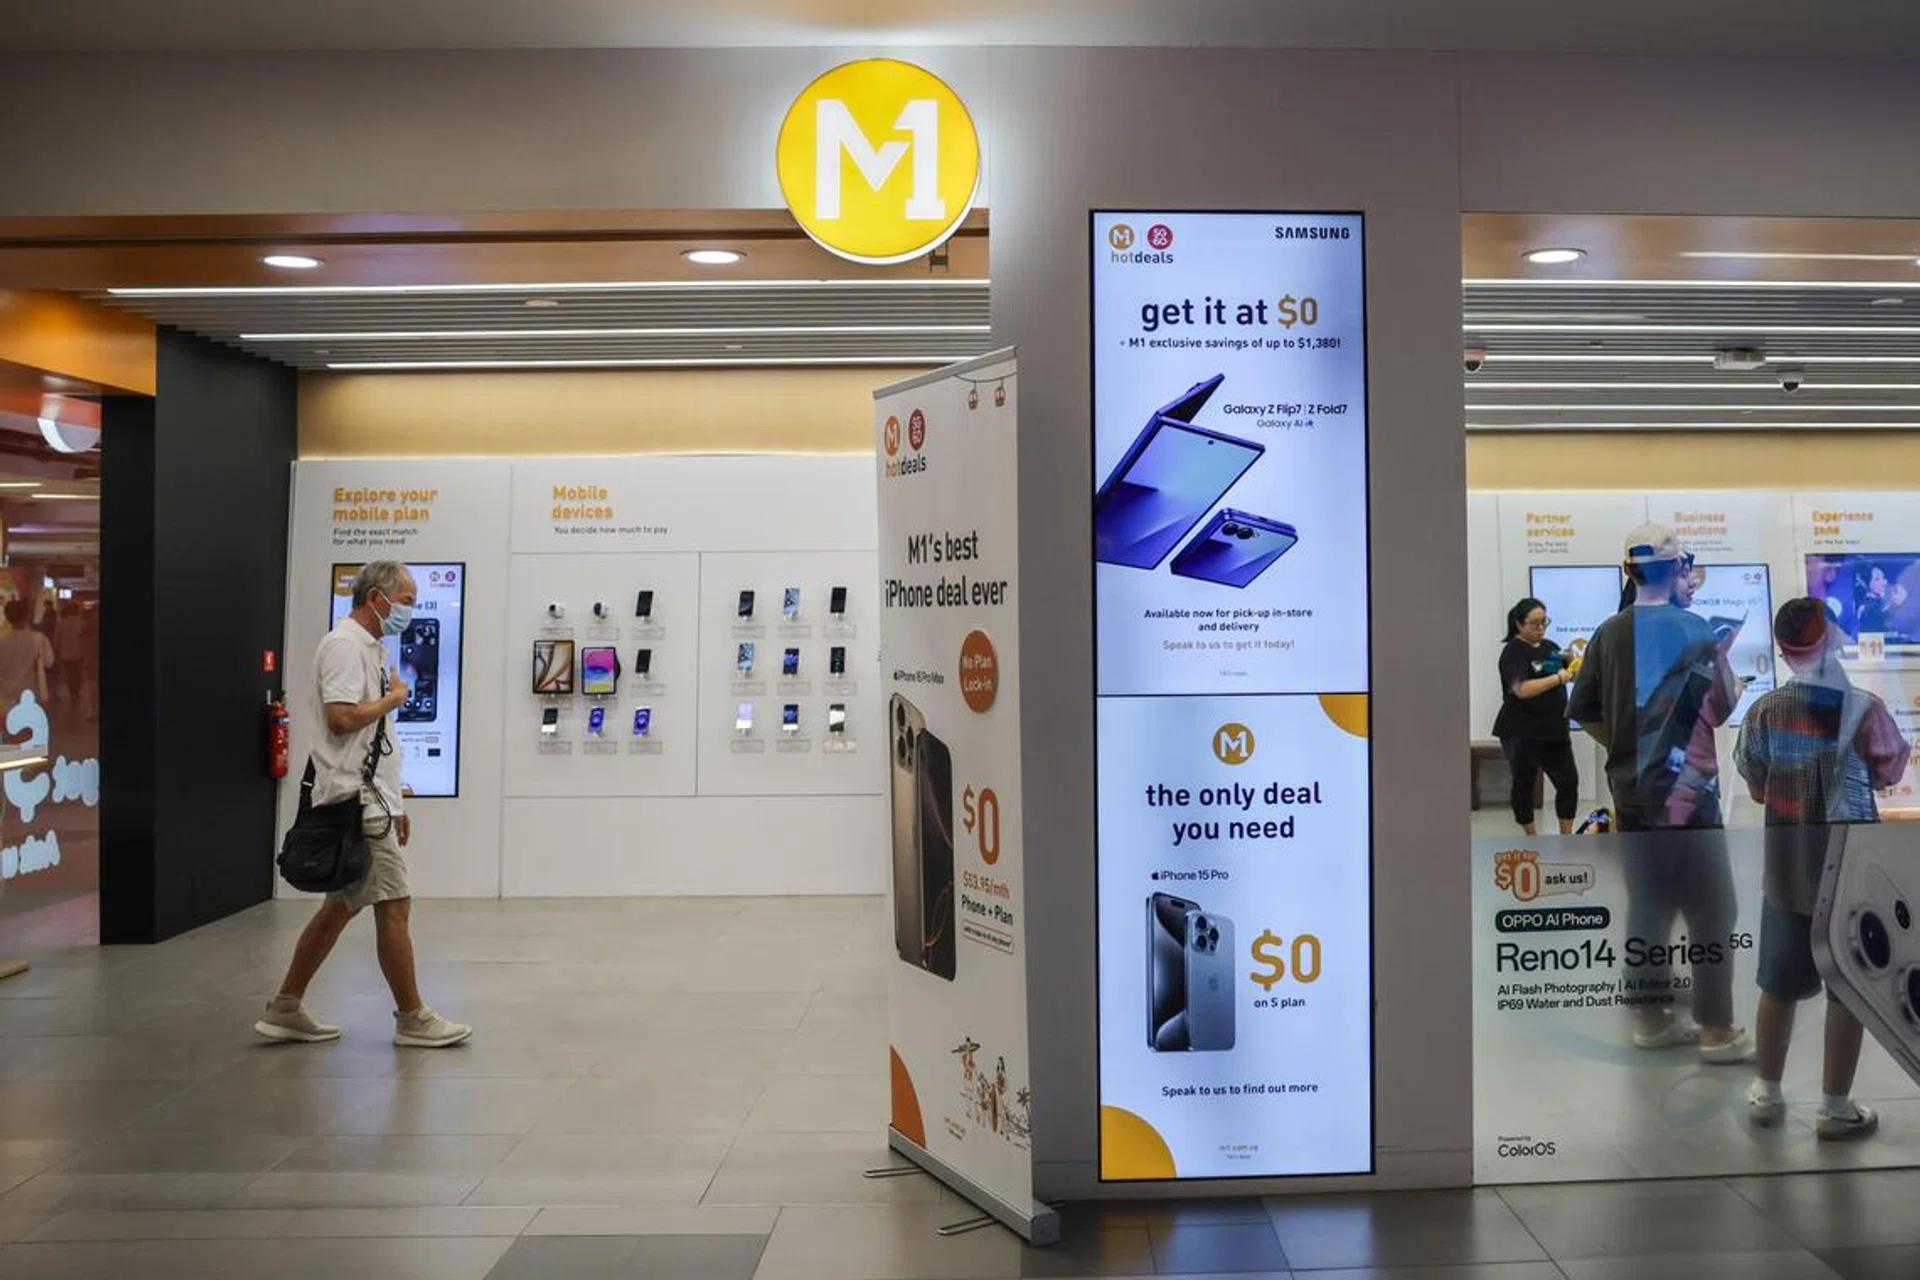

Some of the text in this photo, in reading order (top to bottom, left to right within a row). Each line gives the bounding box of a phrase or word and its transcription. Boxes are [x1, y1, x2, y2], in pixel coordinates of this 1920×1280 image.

[816, 99, 946, 220] M1
[1275, 227, 1351, 240] SAMSUNG
[1141, 294, 1319, 332] get it at $0
[1129, 337, 1145, 348] M1
[1149, 336, 1202, 348] exclusive
[1205, 336, 1249, 351] savings
[1251, 337, 1263, 348] of
[1266, 339, 1281, 350] up
[1283, 338, 1295, 348] to
[1222, 402, 1348, 417] Galaxy Z Flip7 Z Fold7
[1256, 418, 1293, 430] Galaxy
[334, 487, 439, 506] Explore your
[552, 485, 608, 500] Mobile
[333, 505, 431, 523] mobile plan
[552, 503, 613, 519] devices
[1526, 512, 1573, 524] Partner
[1812, 509, 1874, 522] Experience
[554, 526, 569, 534] You
[570, 526, 598, 534] decide
[1526, 527, 1575, 537] services
[908, 530, 979, 565] M1's best
[885, 575, 1008, 609] iPhone deal ever
[1144, 607, 1313, 621] Available now for pick-up in-store
[1198, 621, 1260, 633] and delivery
[1162, 638, 1295, 651] Speak to us to get it today!
[1219, 731, 1249, 758] M1
[1146, 781, 1322, 811] the only deal
[963, 784, 1000, 865] $0
[1172, 815, 1296, 847] you need
[1160, 869, 1230, 881] iPhone 15 Pro
[1495, 861, 1540, 901] $0
[1544, 871, 1588, 885] ask us!
[961, 892, 987, 916] Phone
[994, 903, 1014, 926] Plan
[1502, 911, 1604, 928] OPPO AI Phone
[1250, 929, 1322, 992] $0
[1496, 933, 1753, 973] Reno14 Series 5G
[1497, 984, 1510, 995] AI
[1512, 983, 1542, 995] Flash
[1544, 980, 1616, 996] Photography
[1673, 977, 1692, 989] 2.0
[1254, 997, 1306, 1011] on S plan
[1497, 998, 1524, 1011] IP69
[1525, 998, 1560, 1010] Water
[1563, 997, 1584, 1008] and
[1586, 996, 1612, 1007] Dust
[1162, 1083, 1319, 1098] Speak to us to find out more
[1497, 1141, 1557, 1158] ColorOS
